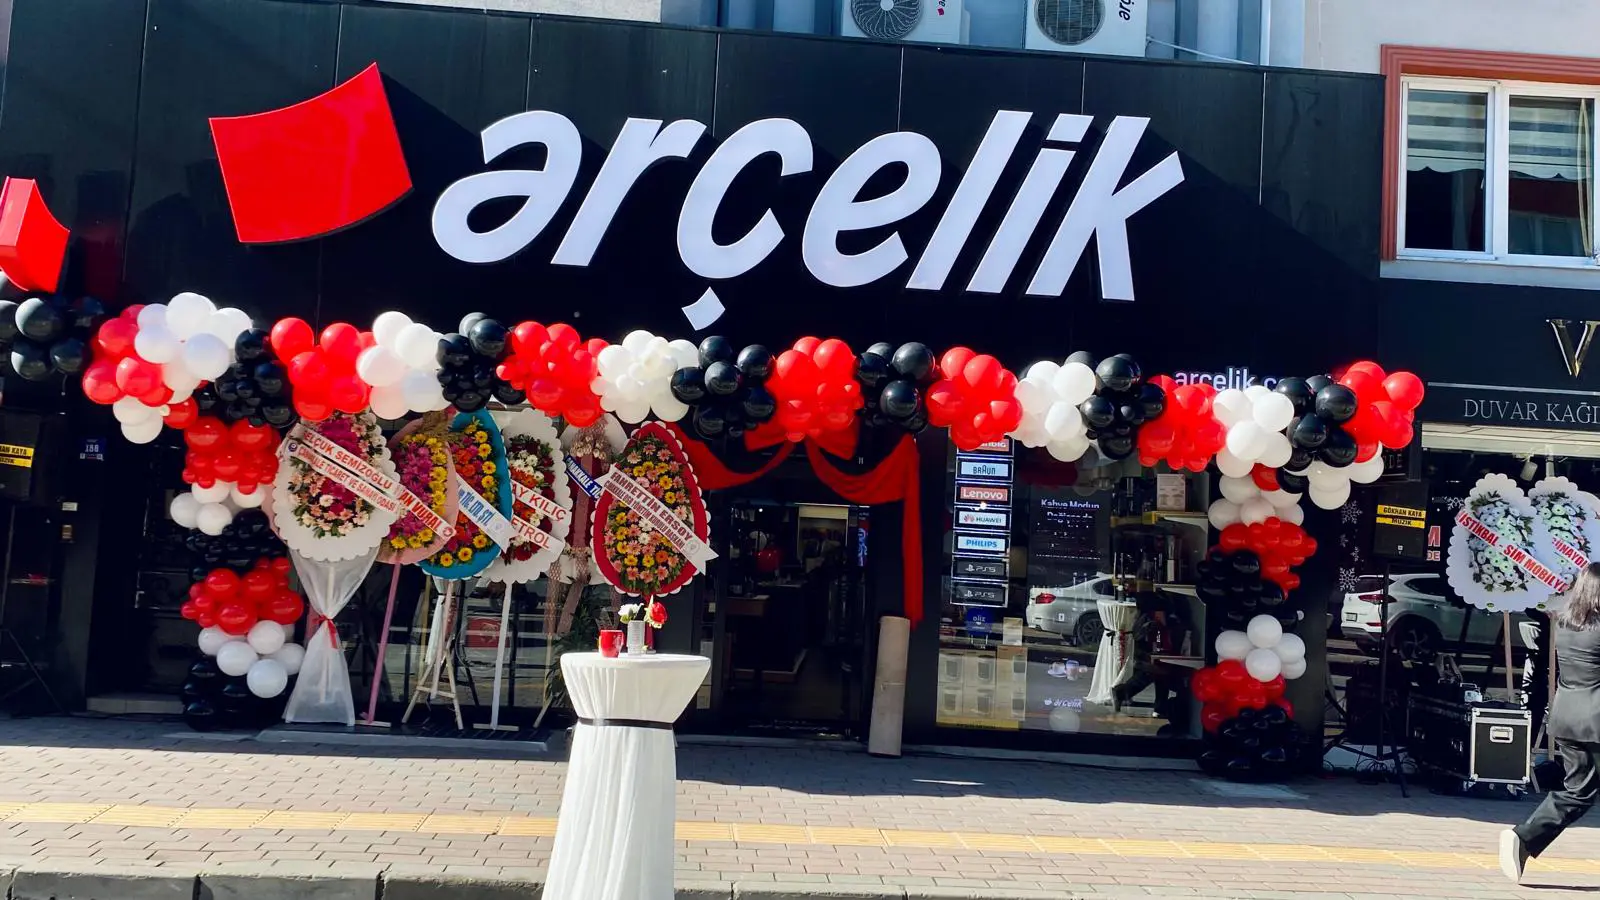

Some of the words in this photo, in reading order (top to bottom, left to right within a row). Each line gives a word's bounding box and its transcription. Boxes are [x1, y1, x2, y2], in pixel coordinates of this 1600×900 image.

[432, 109, 1186, 330] arçelik
[1463, 399, 1539, 421] DUVAR
[963, 488, 1003, 500] Lenovo
[512, 516, 550, 548] ETROL
[660, 509, 693, 541] ERSOY
[966, 539, 997, 548] PHILIPS
[975, 565, 996, 573] PS5
